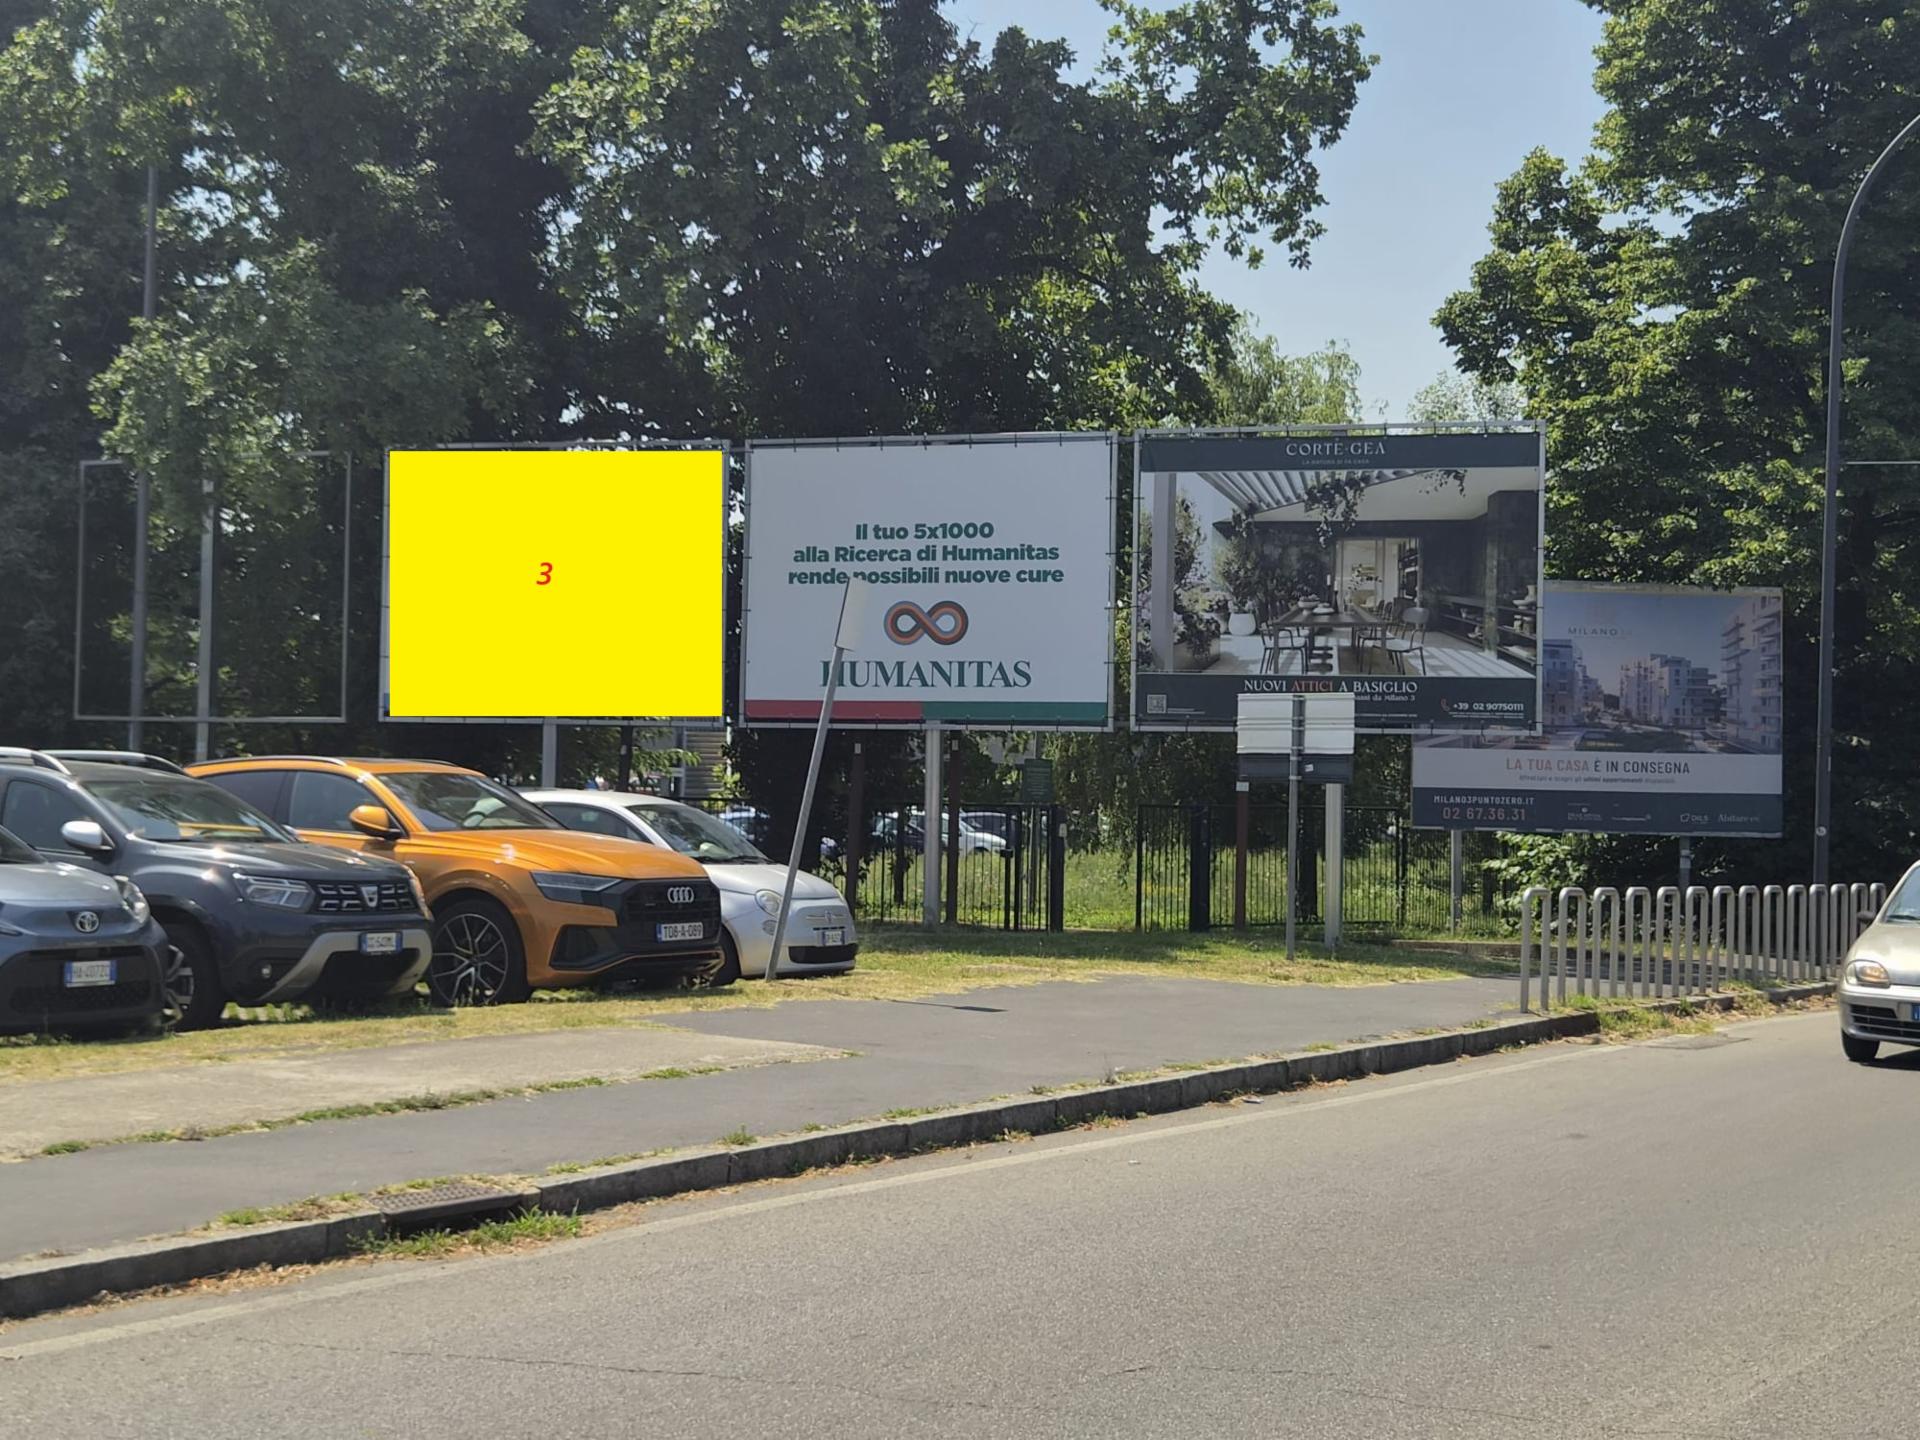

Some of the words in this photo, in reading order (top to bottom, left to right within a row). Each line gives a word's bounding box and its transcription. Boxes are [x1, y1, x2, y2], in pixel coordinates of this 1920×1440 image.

[855, 524, 868, 540] Il
[873, 525, 909, 540] tuo
[913, 522, 994, 540] 5x1000
[793, 546, 830, 563] alla
[834, 546, 912, 562] Ricerca
[916, 545, 937, 561] di
[942, 544, 1060, 561] Humanitas
[788, 568, 849, 585] rende
[945, 569, 1010, 583] nuove
[1016, 568, 1065, 583] cure
[820, 660, 1032, 688] HUMANITAS
[1244, 680, 1287, 692] NUOVI
[1291, 680, 1333, 692] ATTICI
[1339, 682, 1348, 692] A
[1353, 681, 1418, 693] BASIGLIO
[1453, 702, 1469, 710] +39
[1486, 703, 1524, 711] 90750111
[1506, 758, 1522, 770] LA
[1527, 759, 1553, 770] TUA
[1556, 760, 1589, 771] CASA
[1606, 761, 1619, 773] IN
[1623, 761, 1690, 774] CONSEGNA
[1433, 795, 1535, 805] MILANO3PUNTOZERO.IT
[1443, 807, 1460, 819] 02
[1466, 807, 1526, 820] 67.36.31
